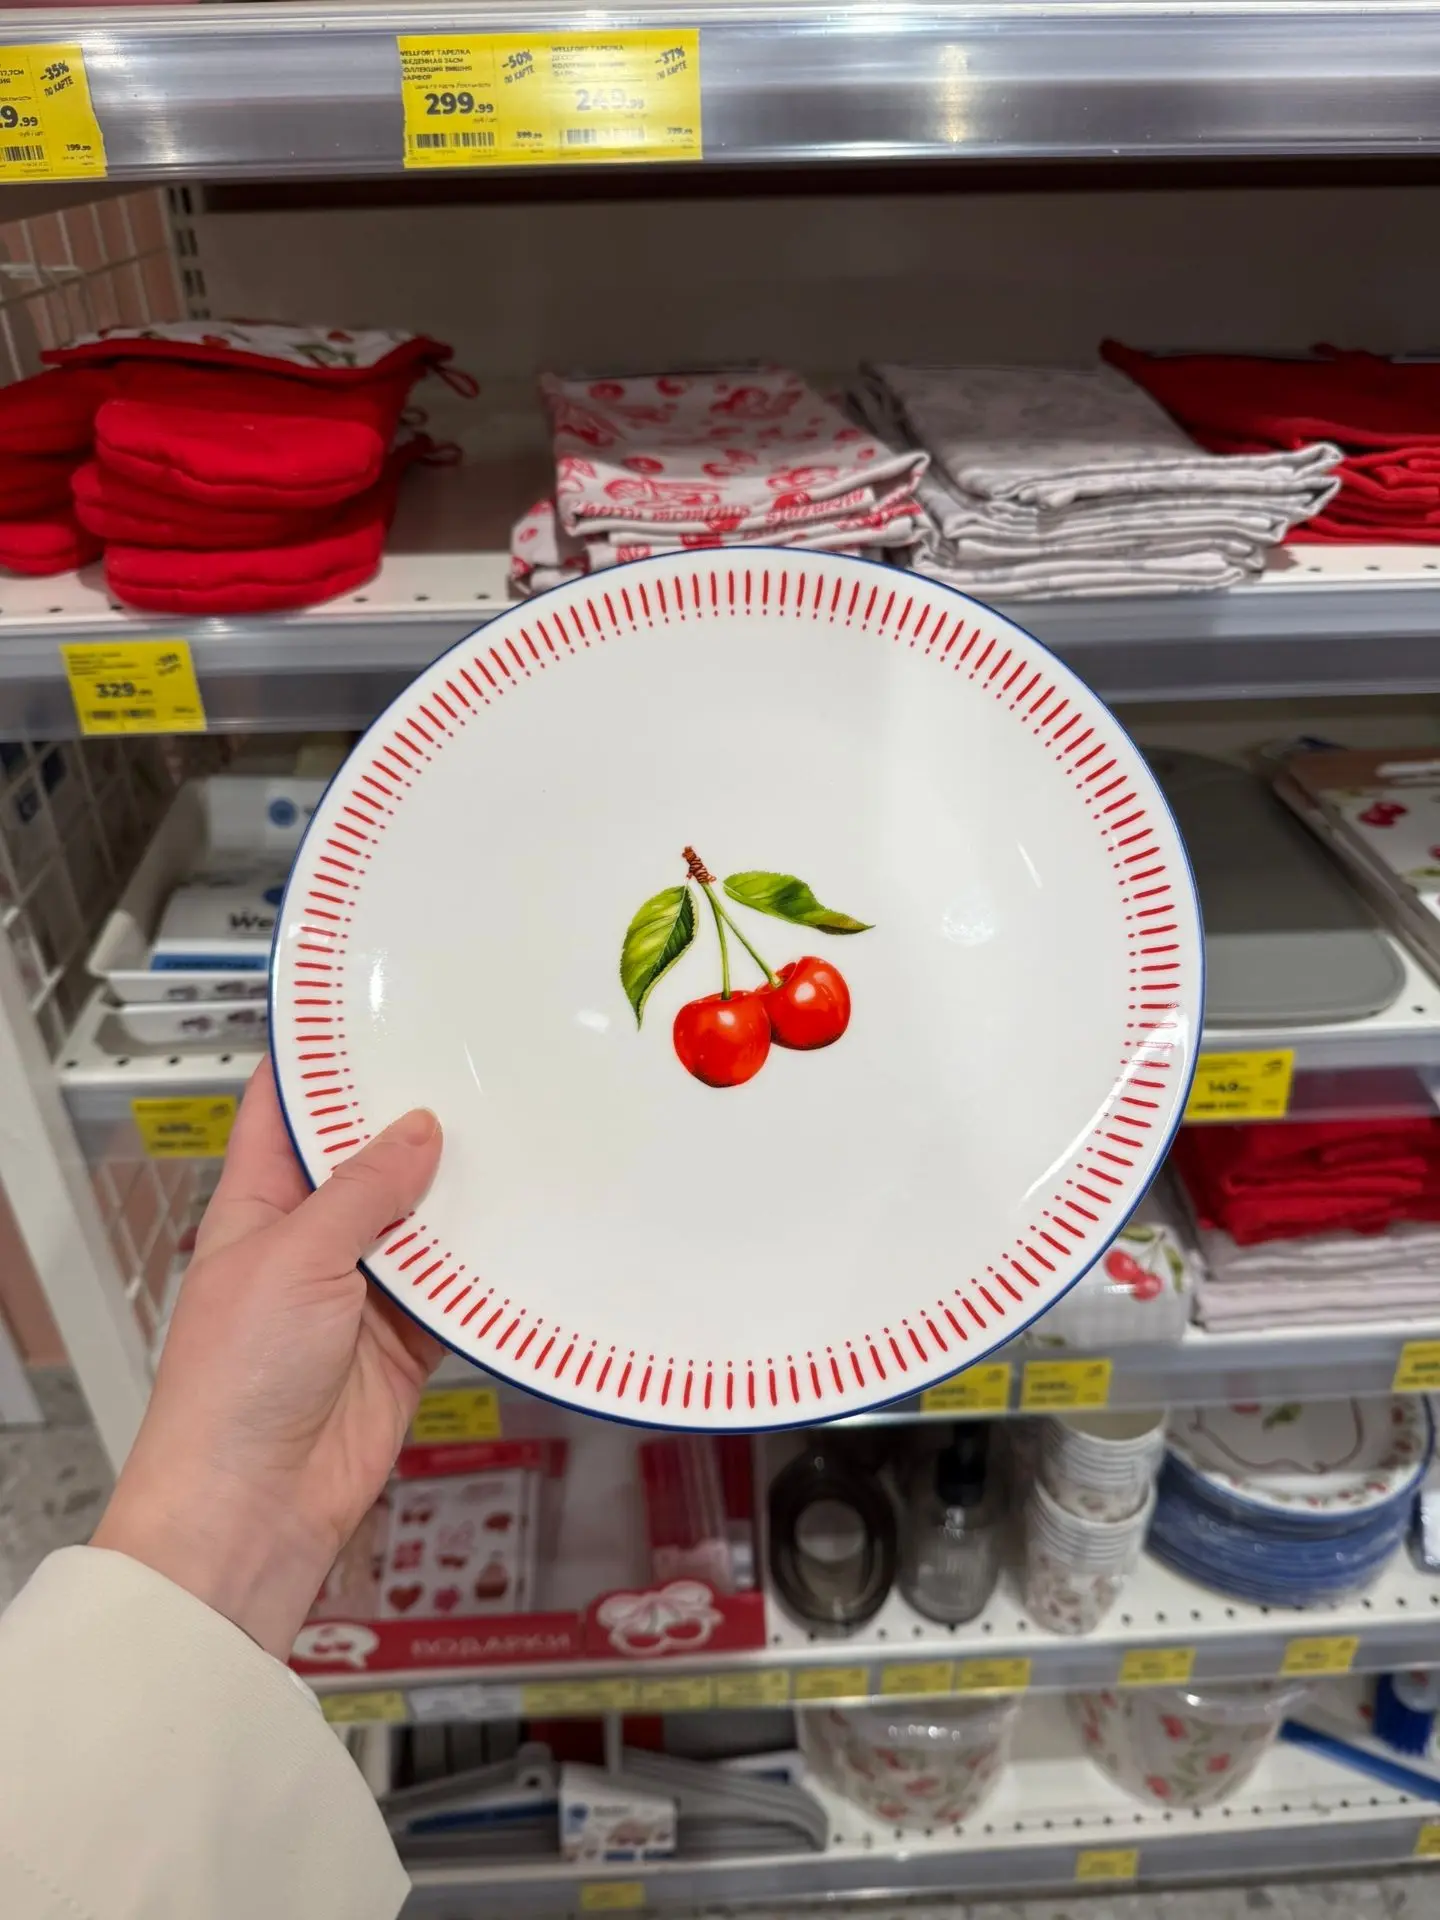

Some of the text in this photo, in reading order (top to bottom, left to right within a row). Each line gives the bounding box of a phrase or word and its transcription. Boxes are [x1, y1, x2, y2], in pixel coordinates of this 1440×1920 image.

[502, 49, 533, 69] -50%
[655, 45, 685, 65] -37%
[40, 60, 70, 81] -35%
[514, 64, 536, 81] КАРТЕ
[666, 60, 688, 77] КАРТЕ
[44, 76, 74, 97] ПО КАРТЕ
[0, 105, 38, 129] 9.99
